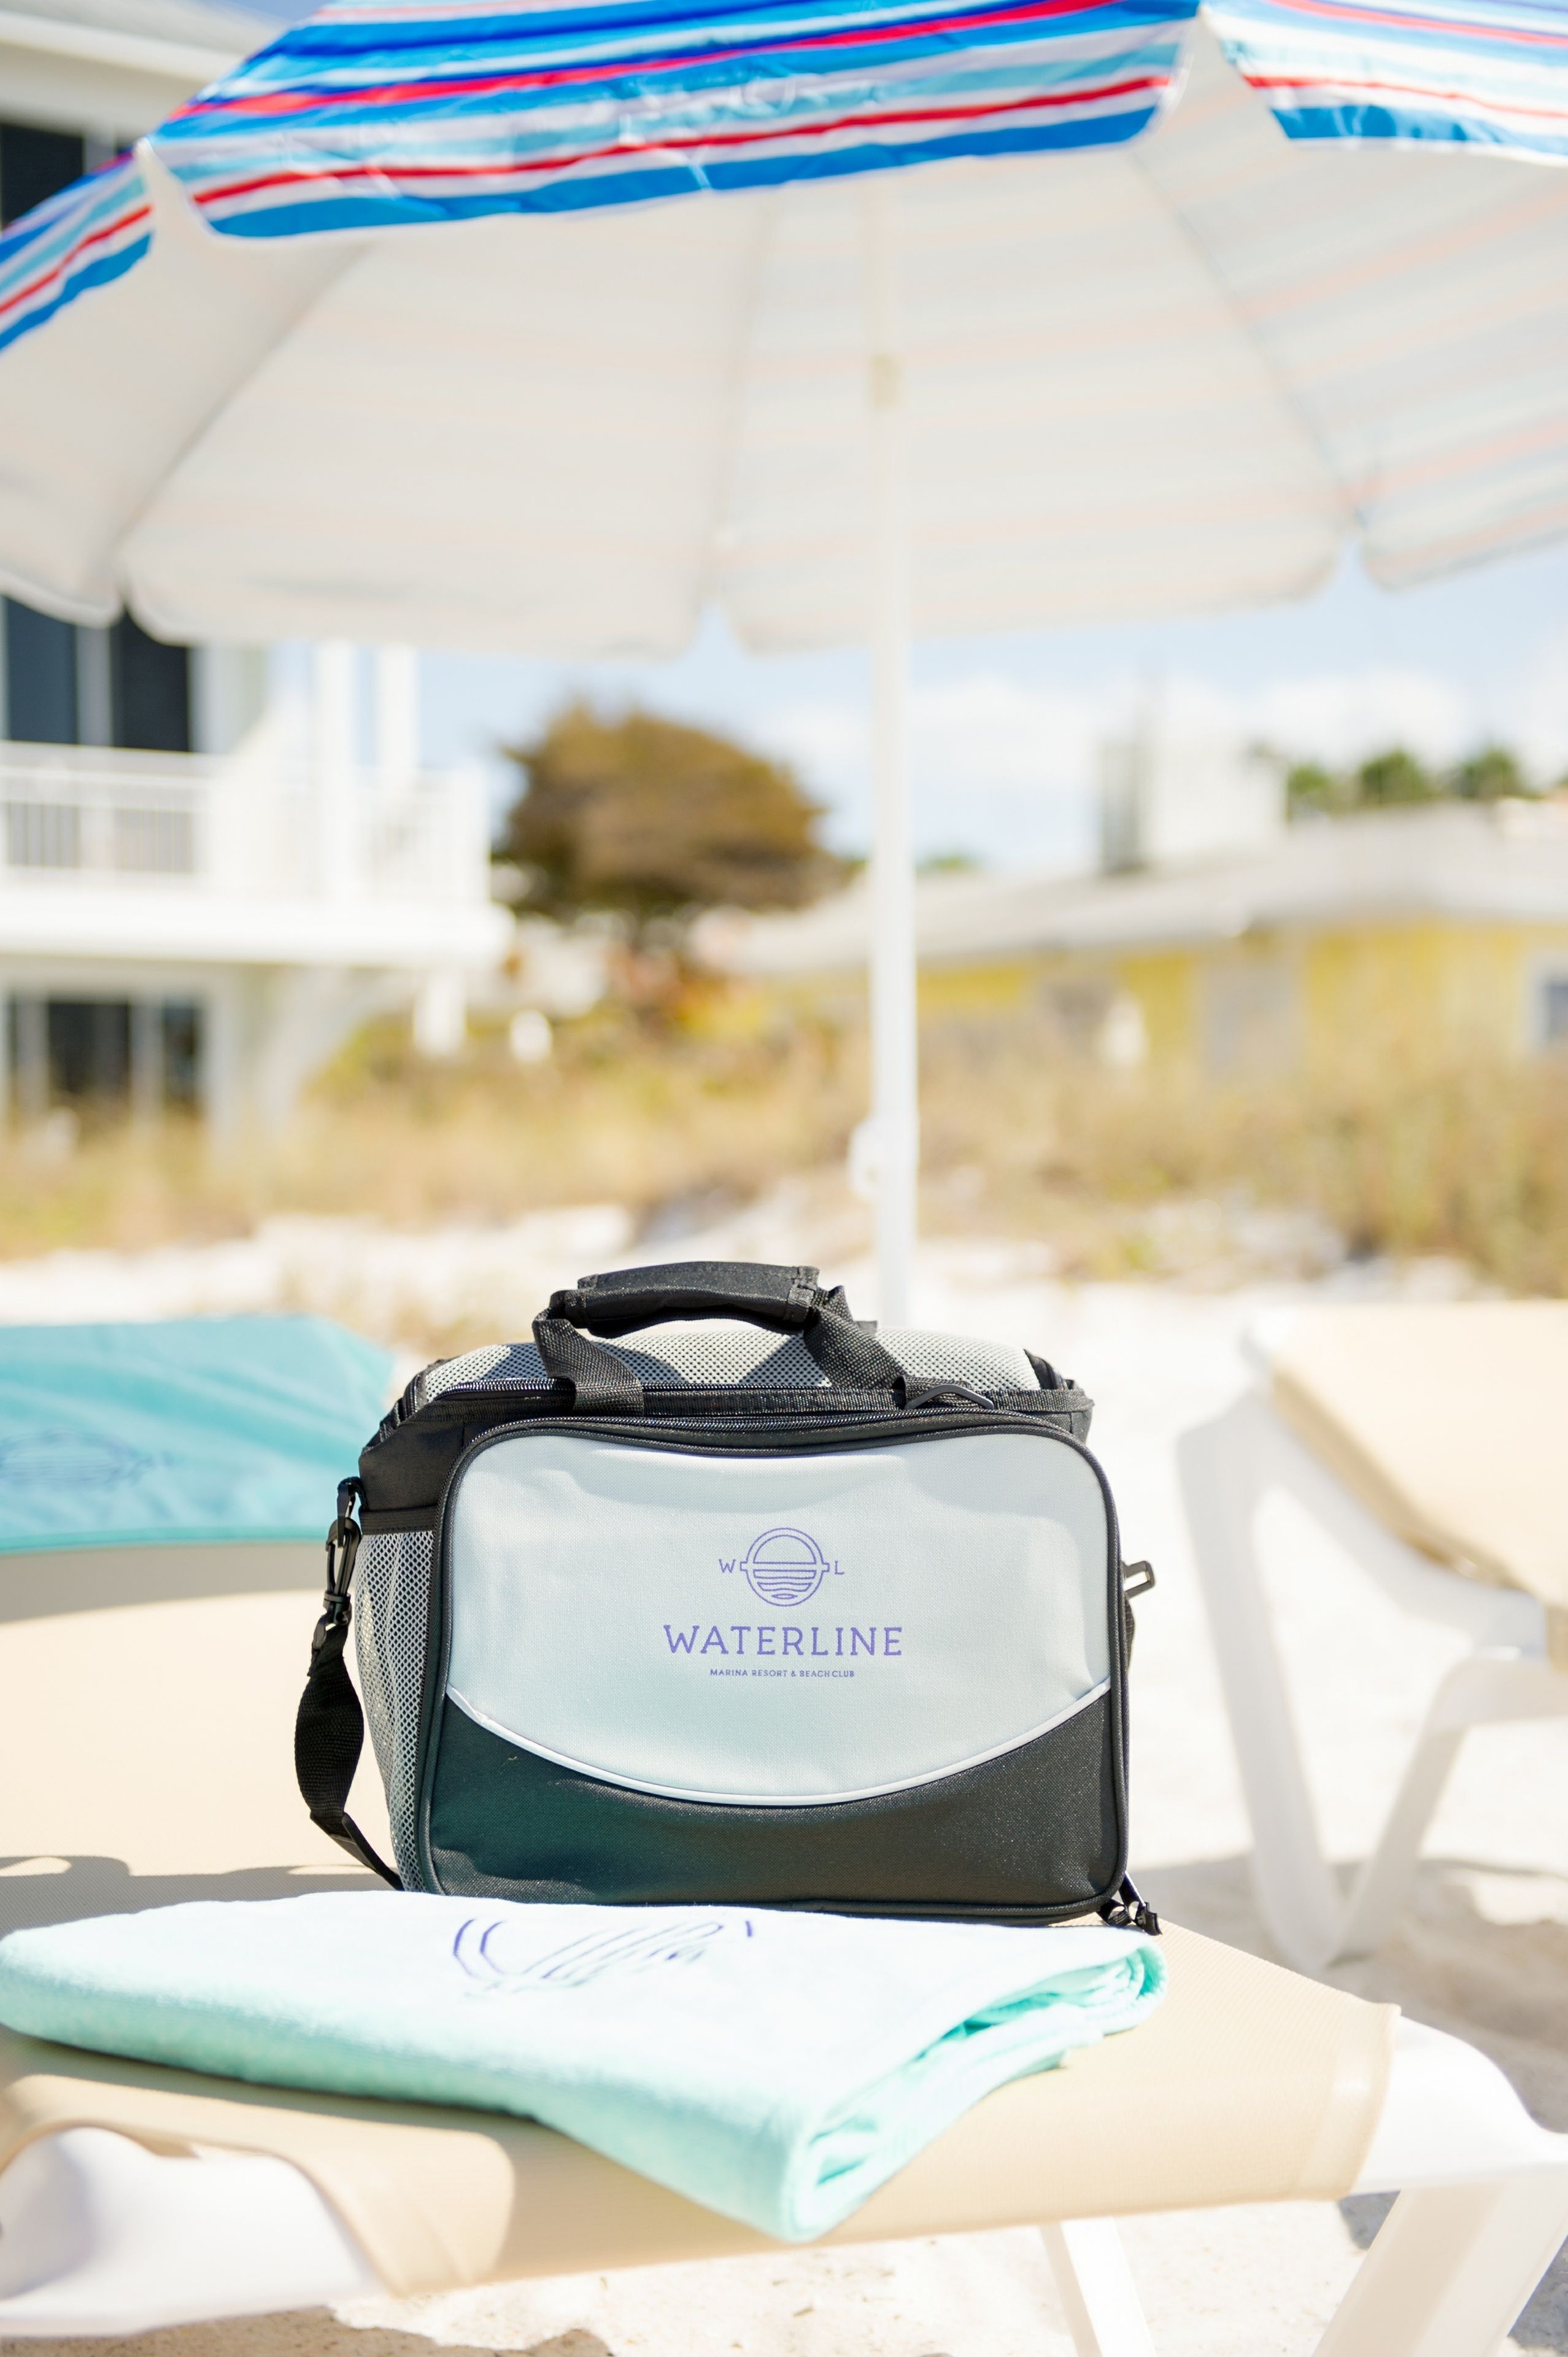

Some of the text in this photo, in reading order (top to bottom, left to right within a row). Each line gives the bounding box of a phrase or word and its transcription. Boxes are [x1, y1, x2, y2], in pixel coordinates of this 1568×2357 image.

[718, 1558, 845, 1576] W L
[663, 1624, 903, 1657] WATERLINE
[709, 1668, 855, 1678] MARINA RESORT & BEACH CLUB
